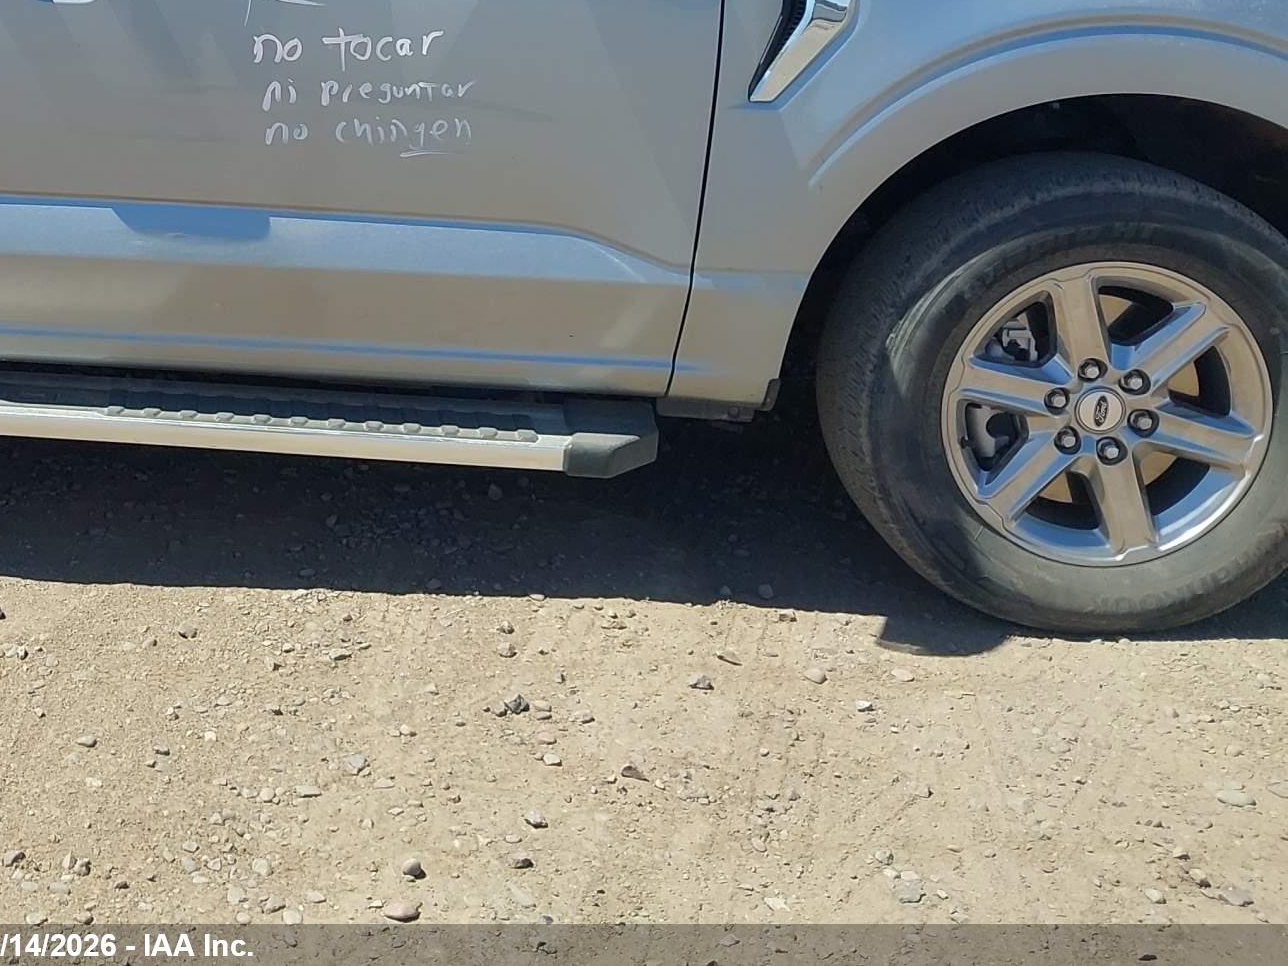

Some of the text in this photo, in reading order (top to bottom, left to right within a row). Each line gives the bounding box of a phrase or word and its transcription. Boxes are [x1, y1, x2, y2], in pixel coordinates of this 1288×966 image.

[252, 27, 444, 72] no tocar
[262, 78, 298, 112] ni
[265, 121, 309, 146] no
